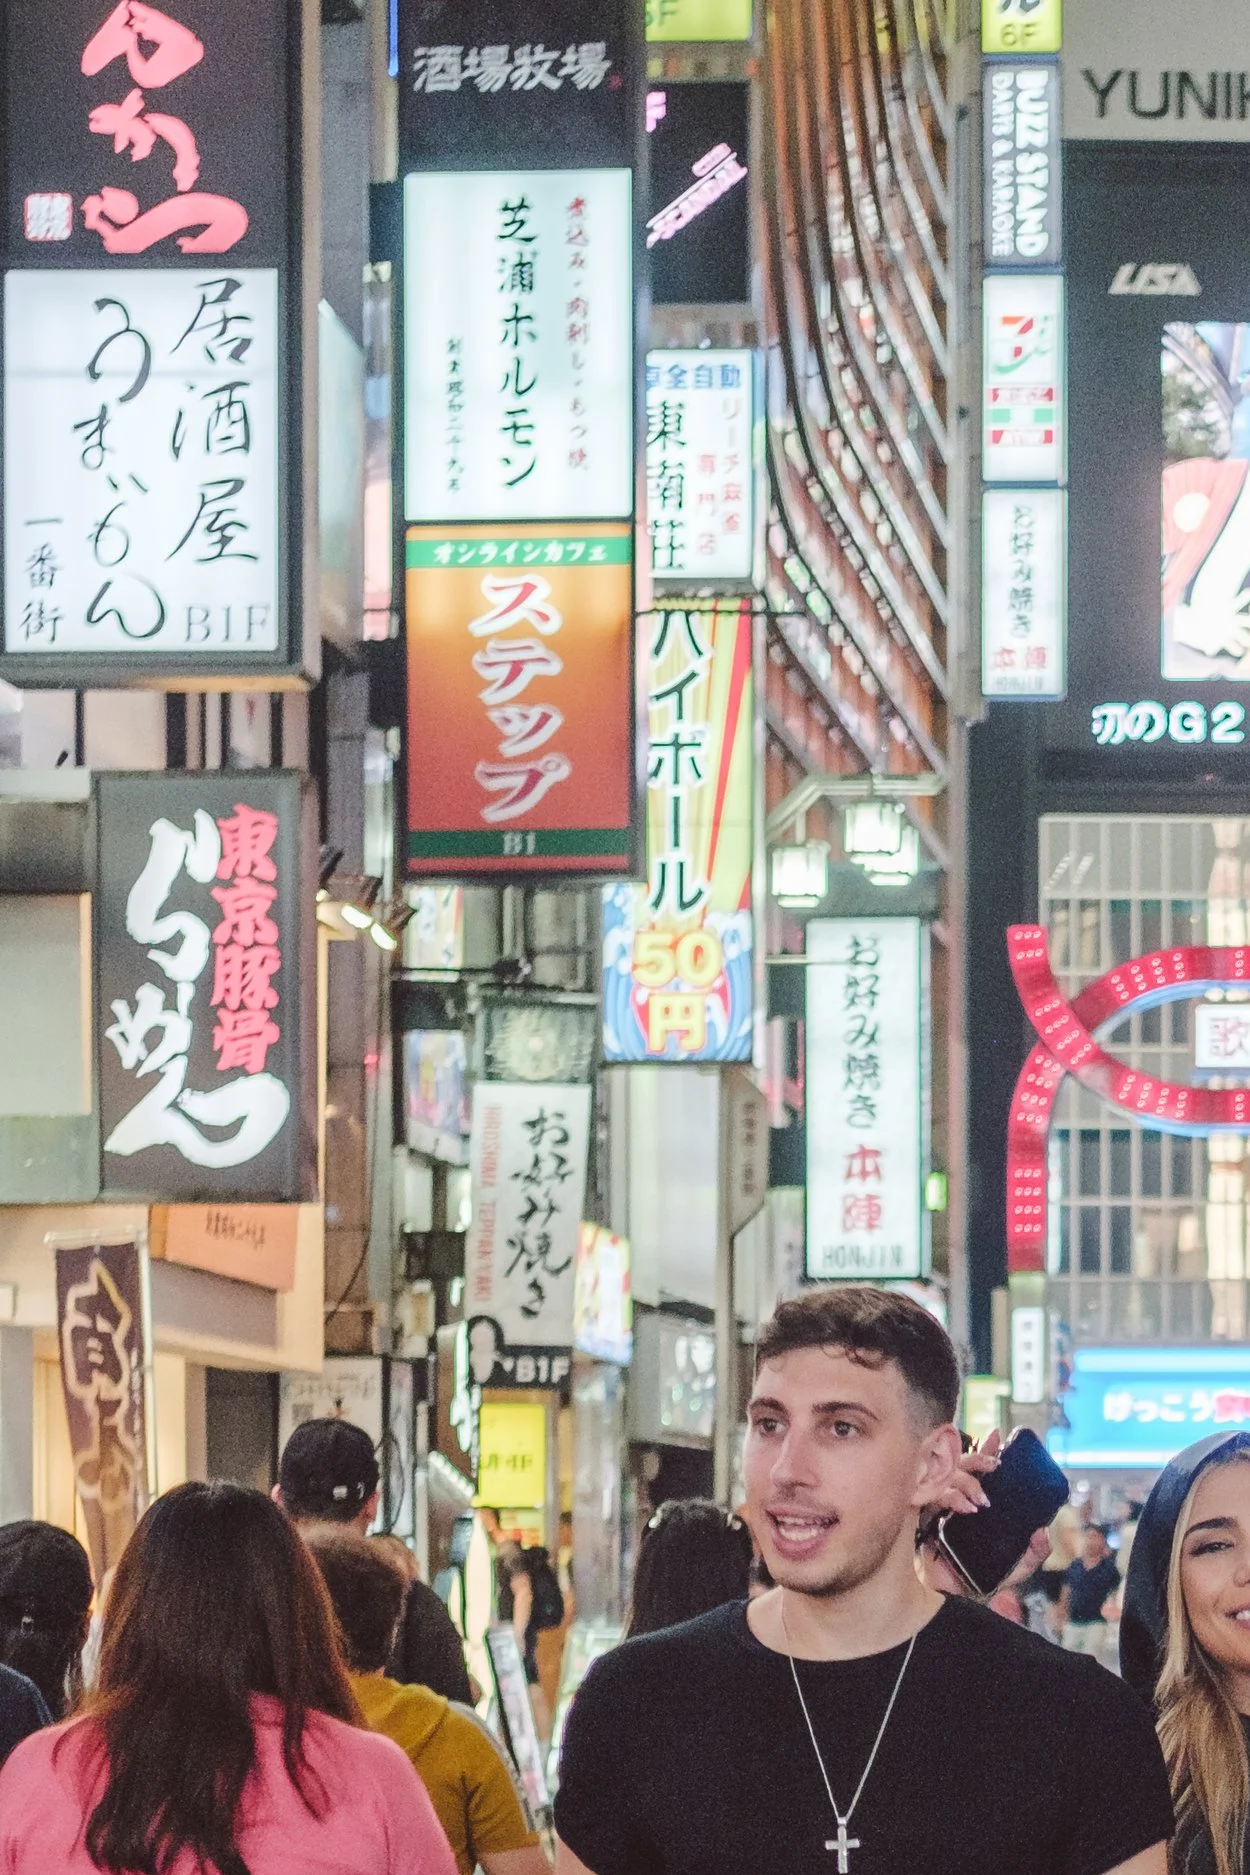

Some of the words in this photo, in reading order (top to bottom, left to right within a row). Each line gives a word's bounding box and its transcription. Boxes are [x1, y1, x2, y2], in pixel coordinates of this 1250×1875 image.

[412, 41, 612, 93] 酒場牧場
[1001, 22, 1041, 46] 6F
[992, 159, 1015, 257] KARAOKE
[1016, 152, 1049, 257] STAND
[497, 196, 539, 488] 芝浦ホルモン
[73, 298, 165, 639] うまいもん
[166, 276, 259, 563] 居酒屋
[18, 516, 64, 643] 一番街
[433, 541, 608, 564] オンラインカフェ
[467, 573, 573, 823] ステップ
[648, 611, 706, 914] ハイボール
[211, 802, 281, 1074] 東京豚骨
[505, 1106, 573, 1319] お好み焼き
[842, 1144, 883, 1234] 本陣
[822, 1245, 904, 1269] HONJIN
[516, 1357, 570, 1384] B1F
